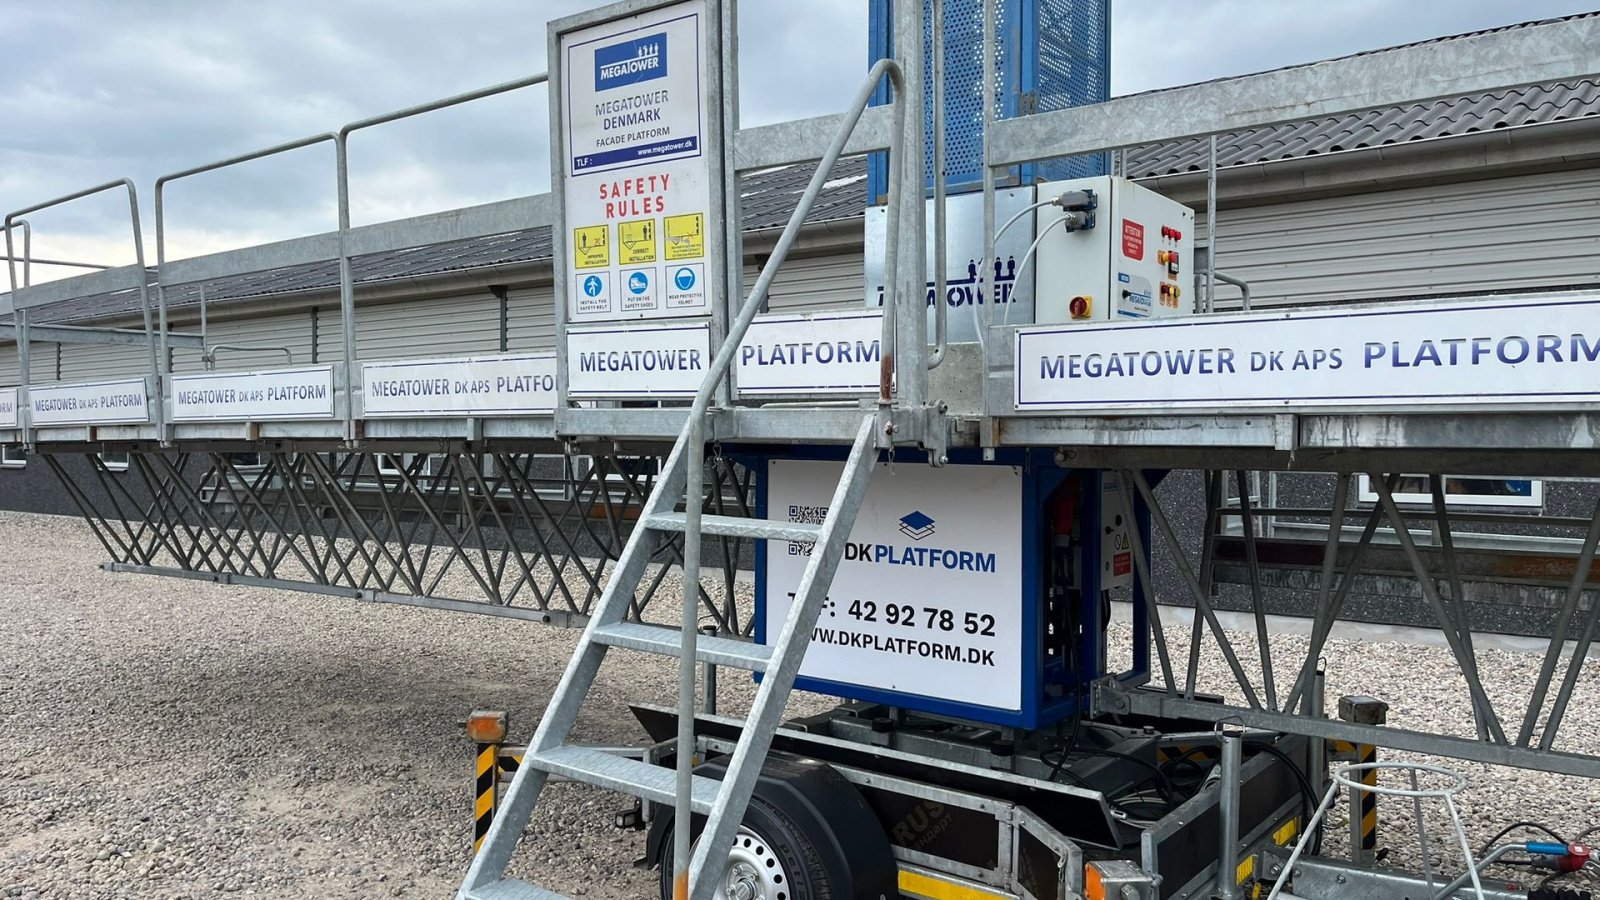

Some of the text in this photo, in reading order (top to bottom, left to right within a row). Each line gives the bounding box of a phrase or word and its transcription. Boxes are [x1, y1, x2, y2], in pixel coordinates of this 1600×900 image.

[600, 57, 659, 80] MEGATOWER
[595, 90, 669, 116] MEGATOWER
[603, 108, 661, 130] DENMARK
[596, 126, 670, 147] FACADE PLATFORM
[638, 140, 693, 156] www.megatower.dk
[600, 174, 670, 200] SAFETY
[606, 195, 665, 218] RULES
[580, 340, 880, 372] MEGATOWER PLATFORM
[1040, 333, 1600, 379] MEGATOWER DK APS PLATFORM
[178, 384, 326, 405] MEGATOWER DK APS PLATFORM
[372, 374, 558, 397] MEGATOWER DK APS PLATFO
[35, 398, 77, 411] MEGATOWER
[87, 400, 98, 409] APS
[100, 394, 142, 408] PLATFORM
[848, 599, 877, 622] 42
[886, 603, 915, 627] 92
[923, 607, 954, 632] 78
[964, 612, 995, 637] 52
